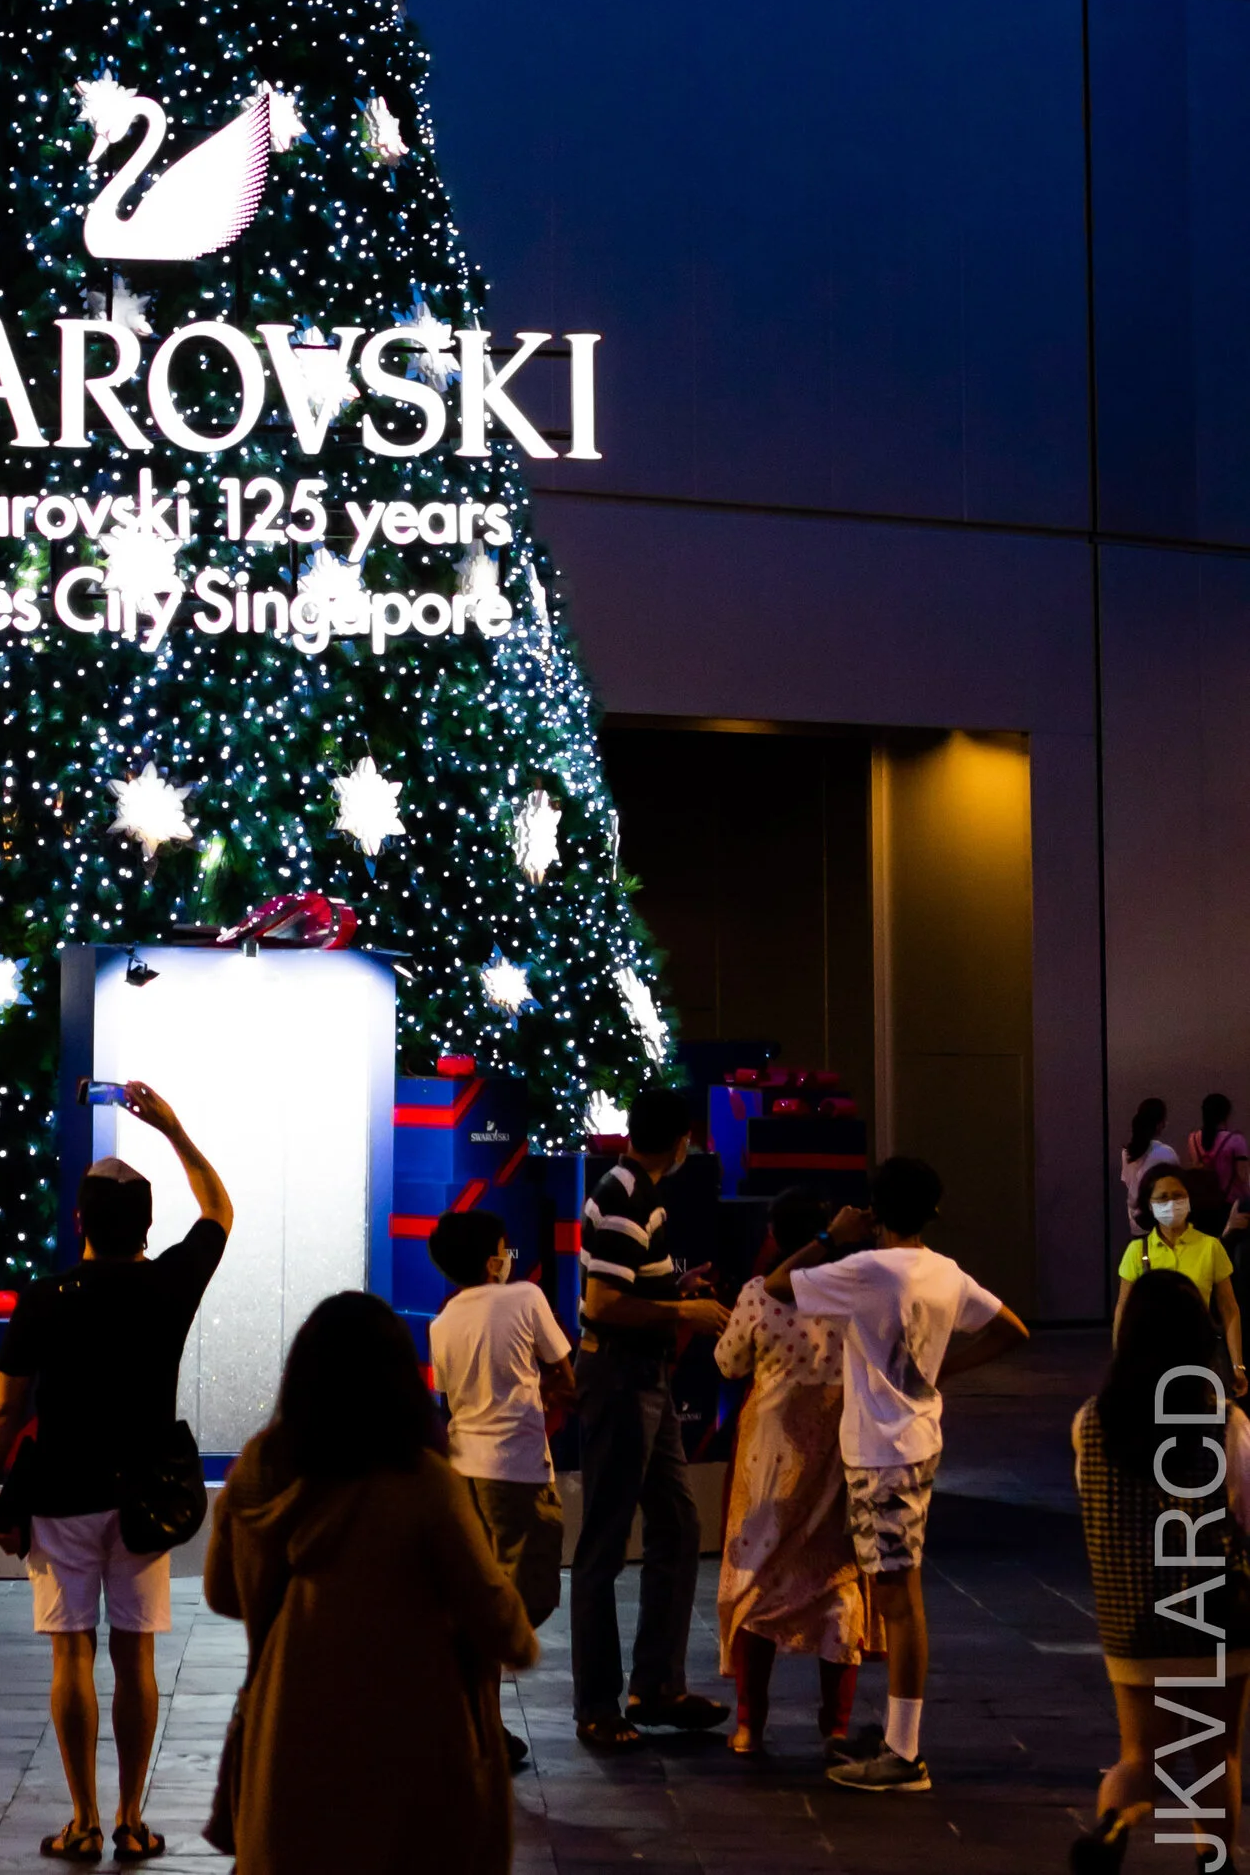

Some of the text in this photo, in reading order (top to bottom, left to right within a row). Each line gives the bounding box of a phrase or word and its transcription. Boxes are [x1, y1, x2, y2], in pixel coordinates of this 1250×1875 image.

[219, 477, 327, 542] 125
[345, 501, 512, 563] years
[54, 566, 184, 652] City
[193, 568, 512, 654] Singapore
